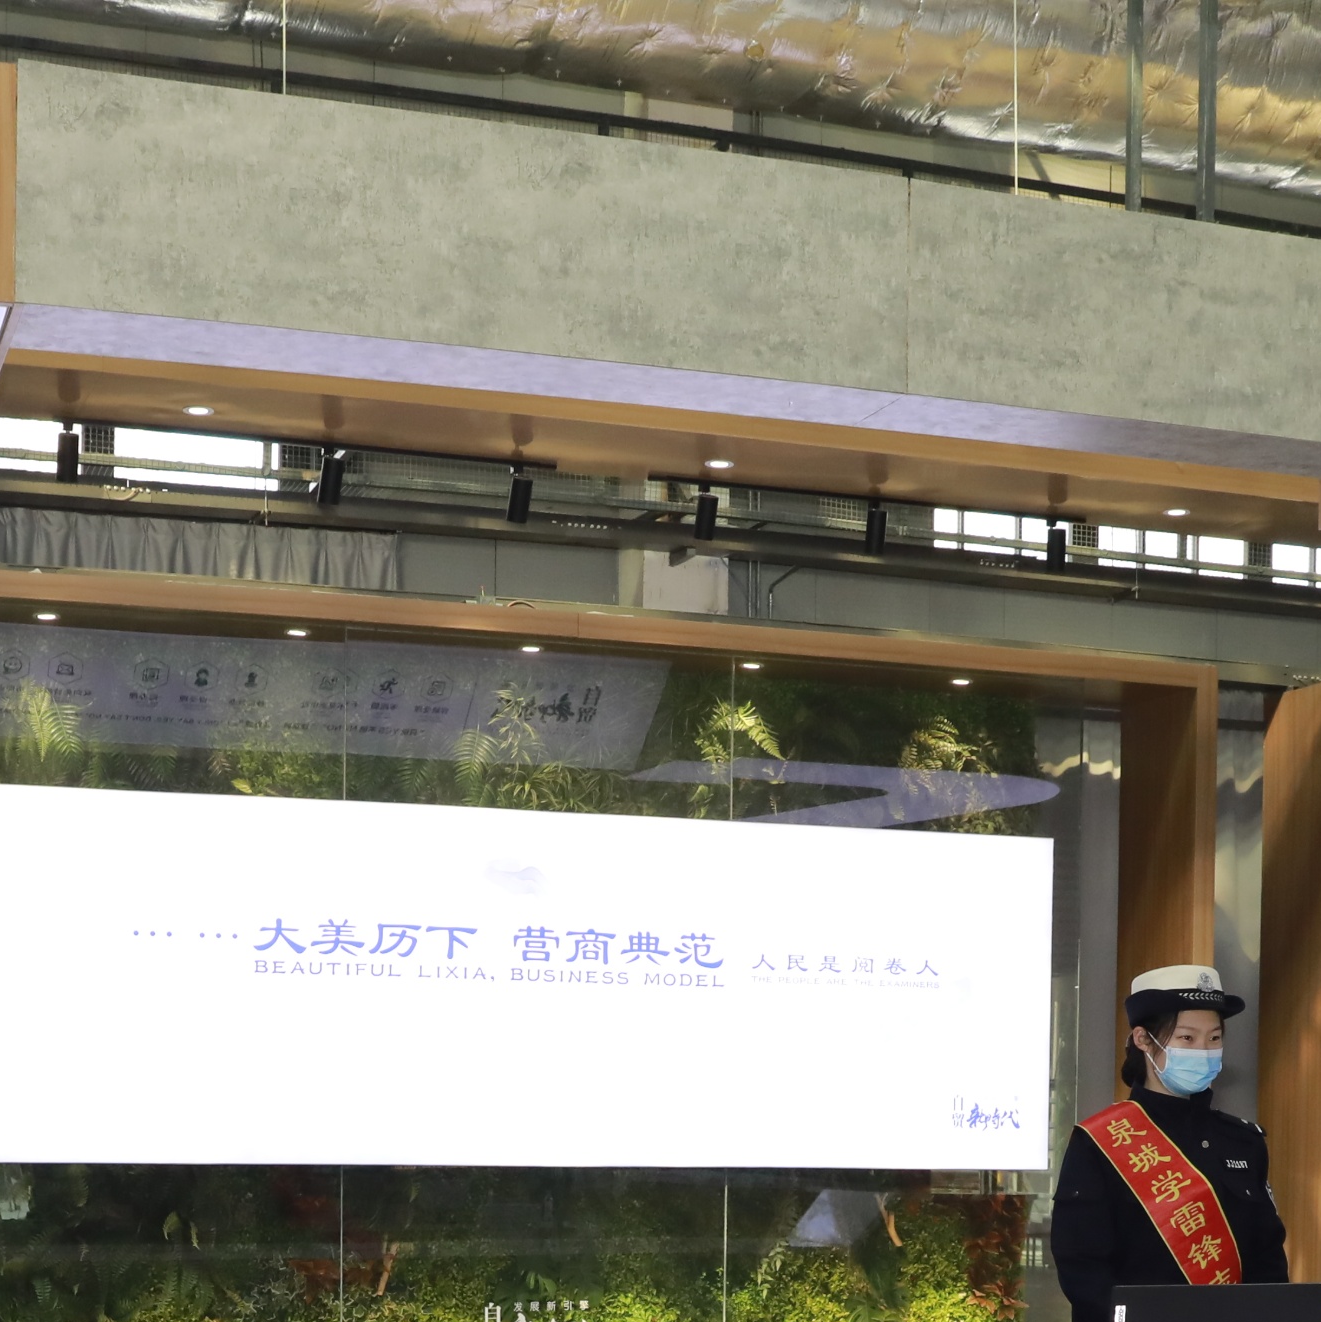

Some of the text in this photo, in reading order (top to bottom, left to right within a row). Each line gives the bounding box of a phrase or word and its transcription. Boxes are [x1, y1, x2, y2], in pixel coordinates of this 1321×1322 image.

[253, 918, 939, 976] 大美历下 营商典范 人民是阅卷人
[254, 960, 725, 988] BEAUTIFUL LIXIA, BUSINESS MODEL
[514, 1301, 590, 1312] 发展新引擎
